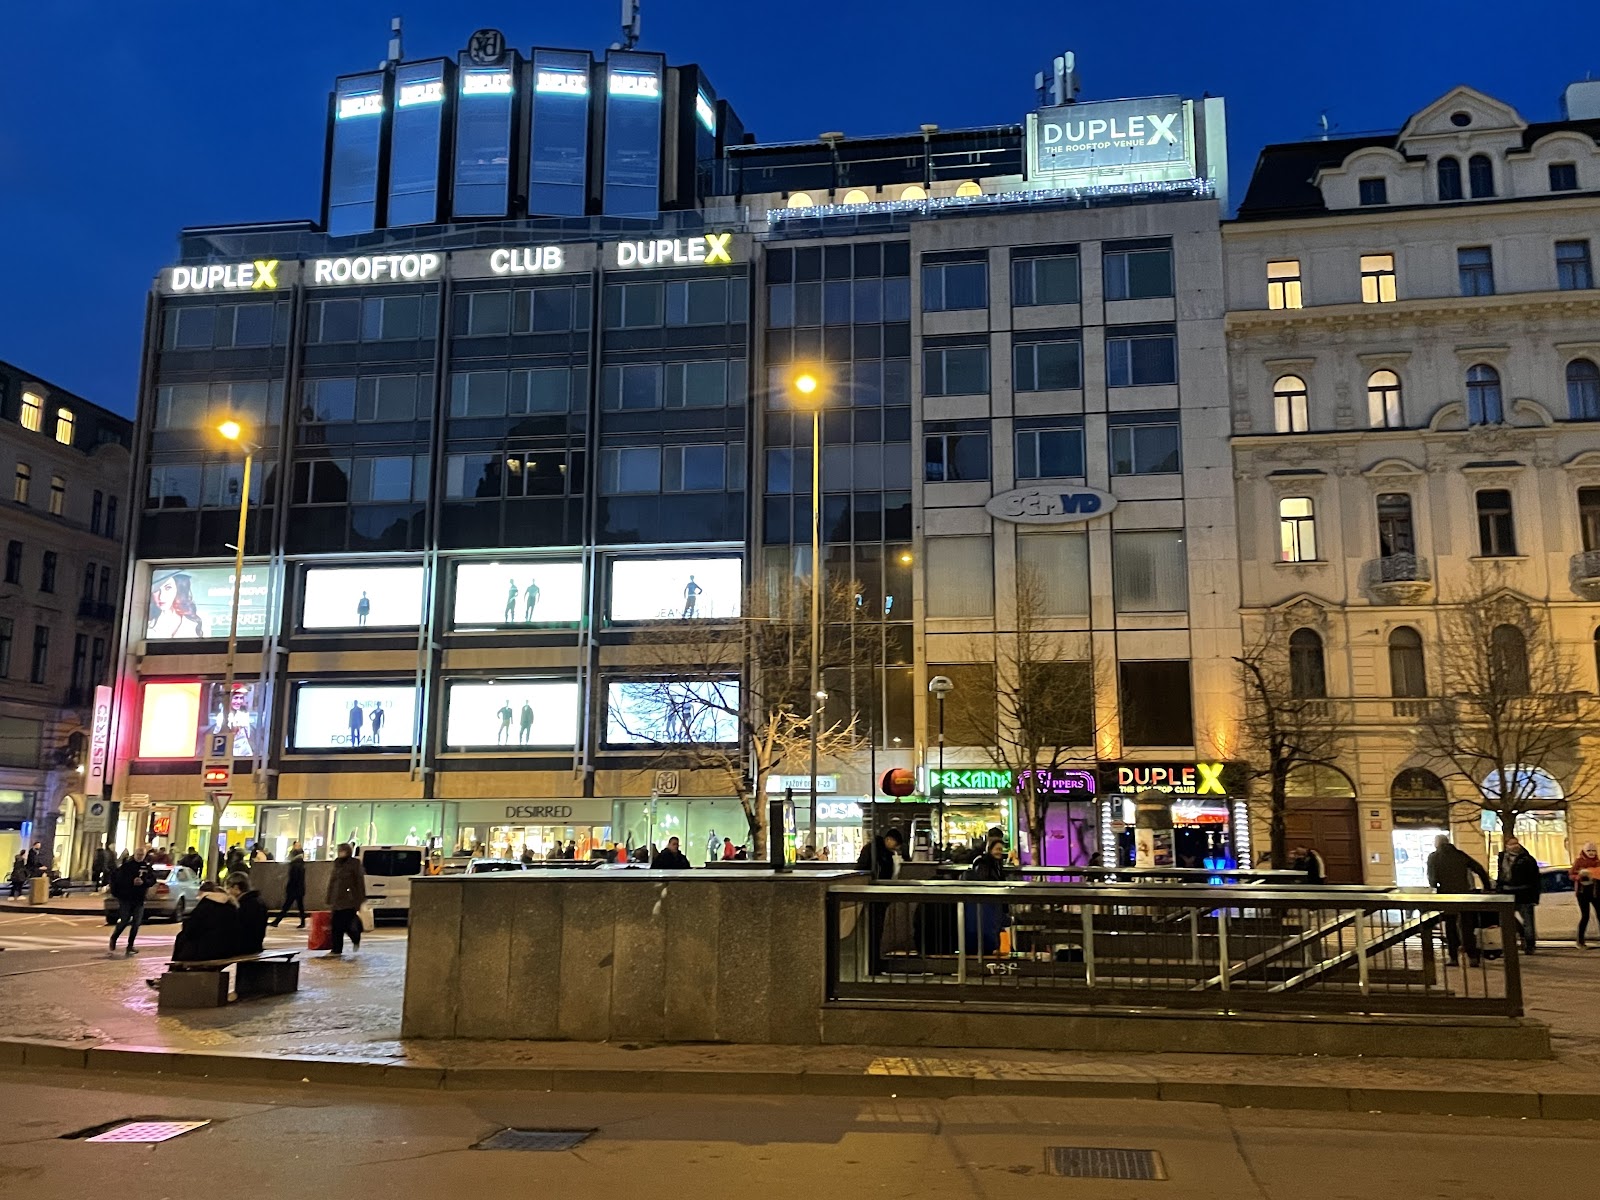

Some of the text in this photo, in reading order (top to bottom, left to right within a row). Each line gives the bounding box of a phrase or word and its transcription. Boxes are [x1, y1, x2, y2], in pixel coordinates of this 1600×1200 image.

[1044, 113, 1178, 145] DUPLEX
[1045, 139, 1145, 154] THE ROOFTOP VENUE
[171, 233, 731, 291] DUPLEX ROOFTOP CLUB DUPLEX
[213, 737, 224, 751] P
[1118, 763, 1226, 794] DUPLEX
[505, 806, 573, 818] DESIRRED
[1112, 796, 1122, 812] P
